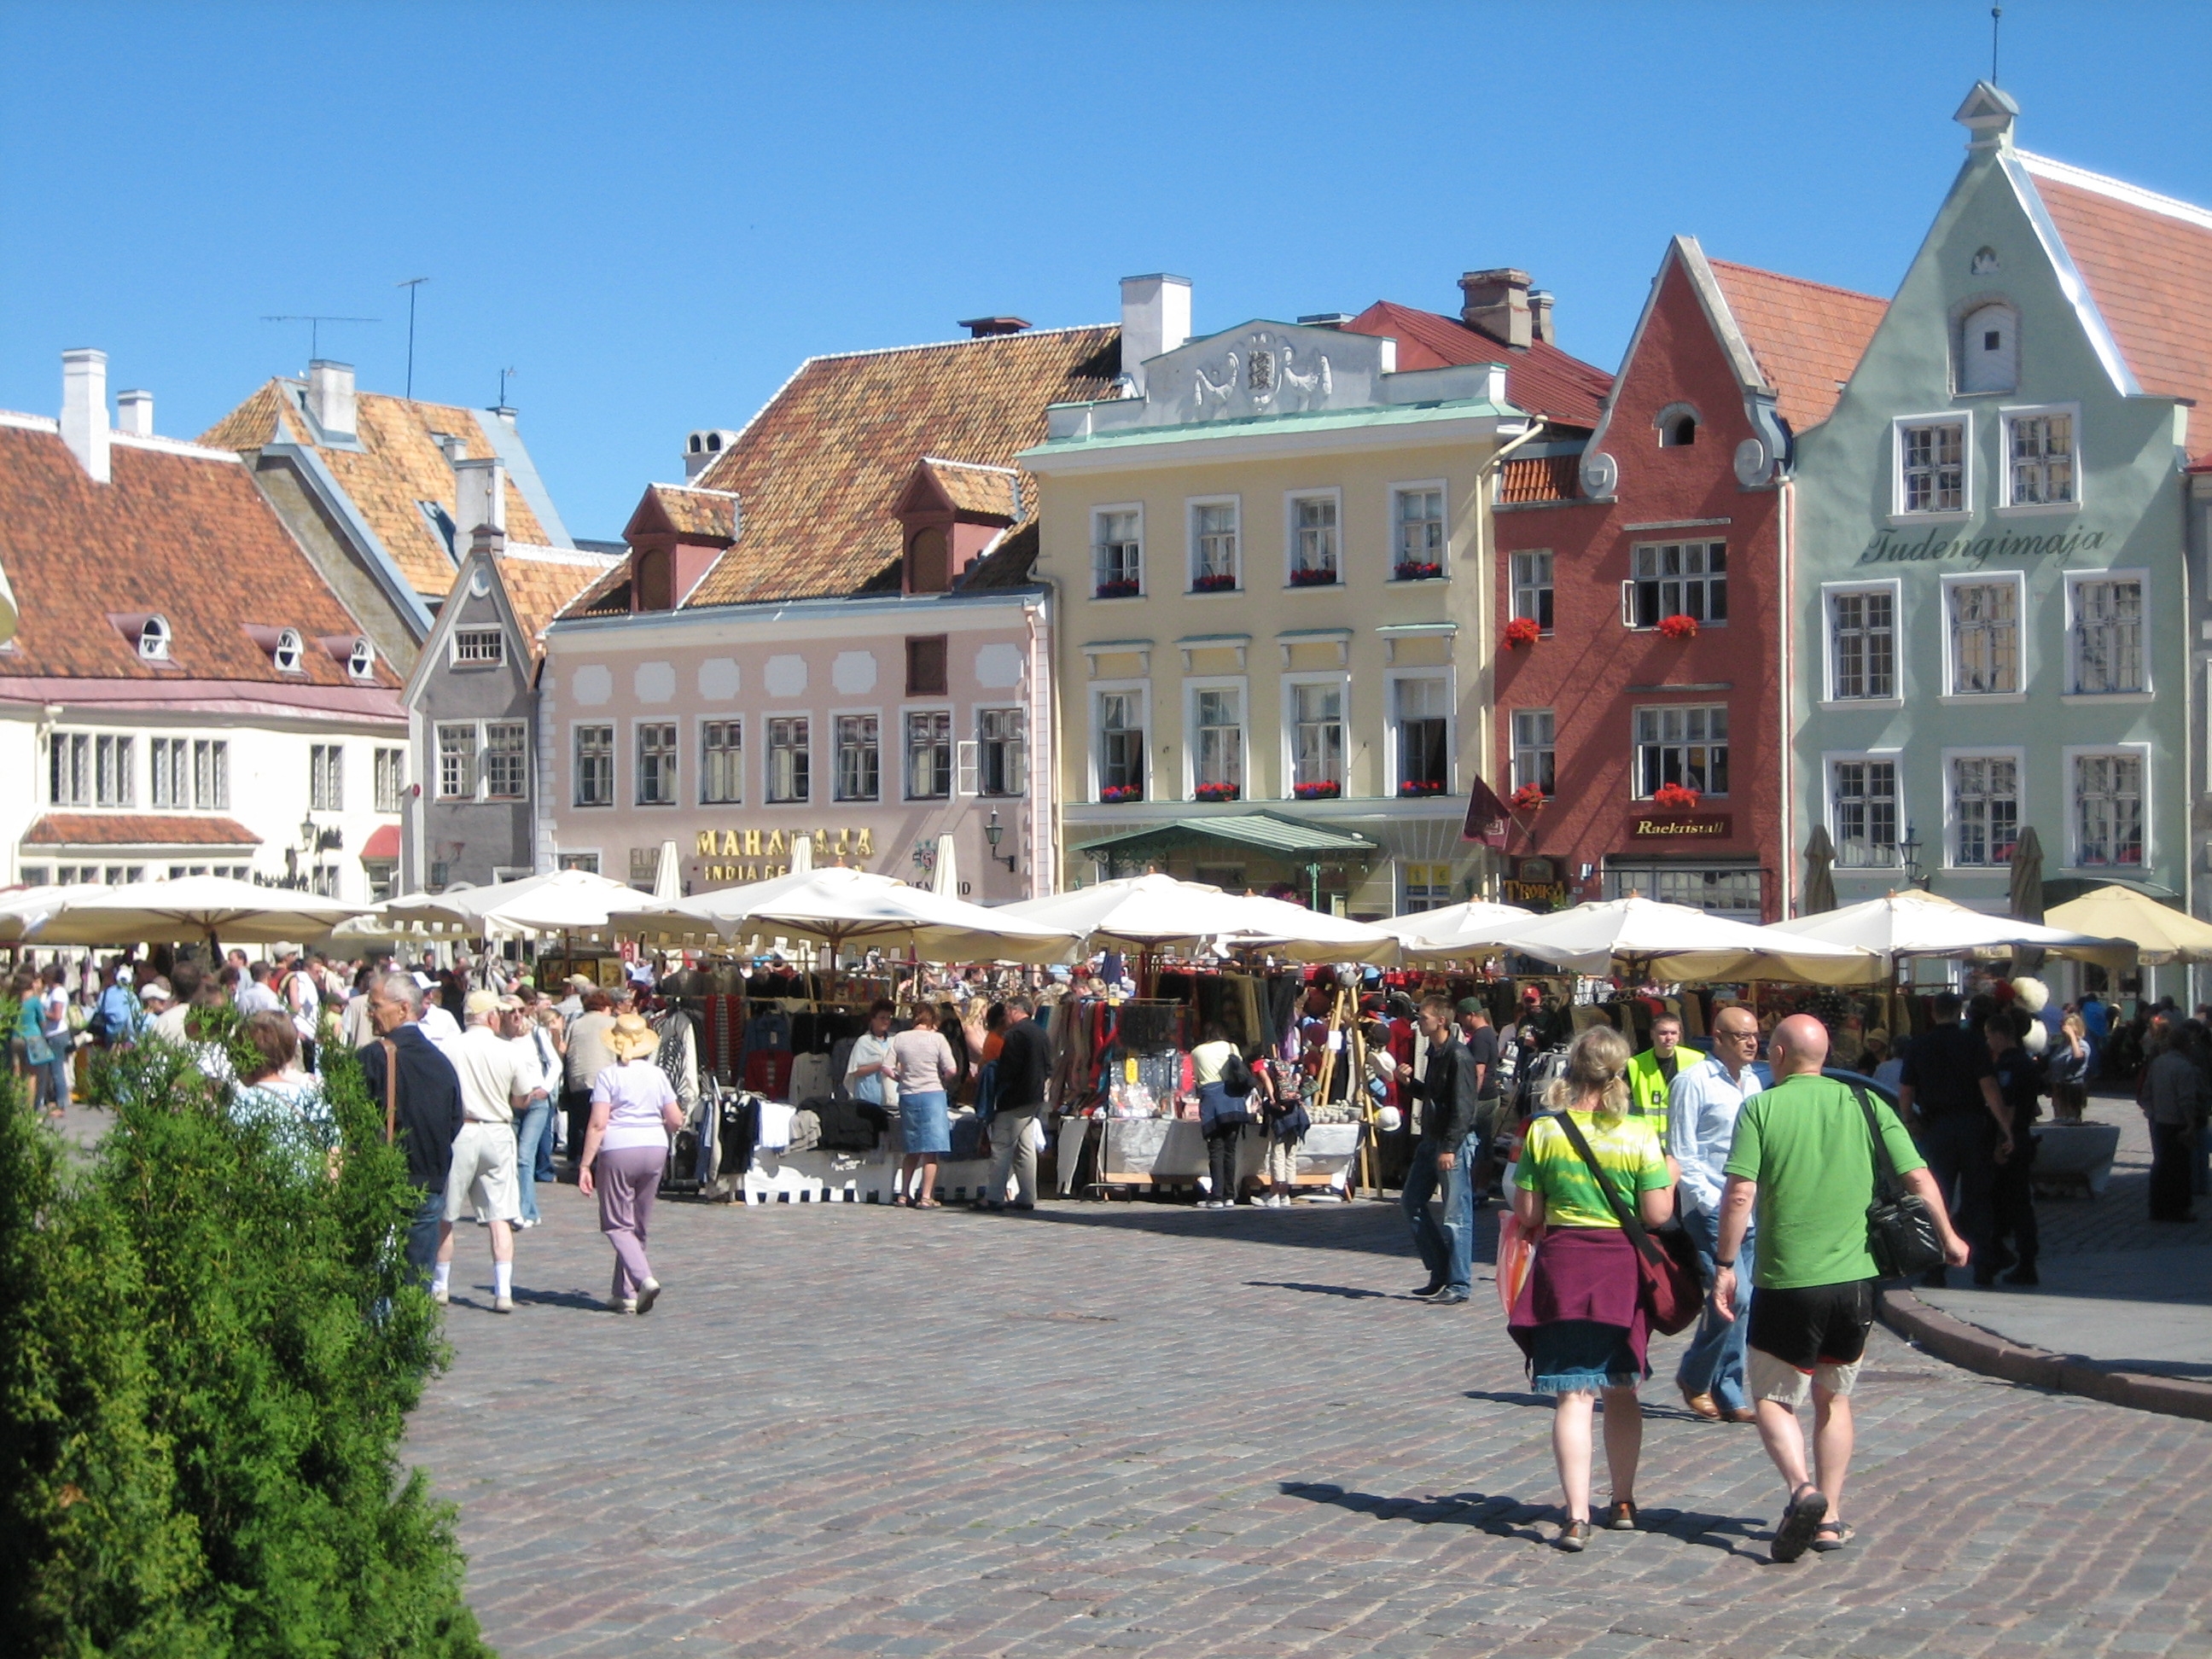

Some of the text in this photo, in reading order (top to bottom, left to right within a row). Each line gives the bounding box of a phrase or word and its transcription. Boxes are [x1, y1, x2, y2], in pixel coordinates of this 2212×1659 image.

[1861, 525, 2111, 569] Tudengimaja
[1637, 820, 1723, 834] Raekristall
[705, 864, 757, 880] INDIA
